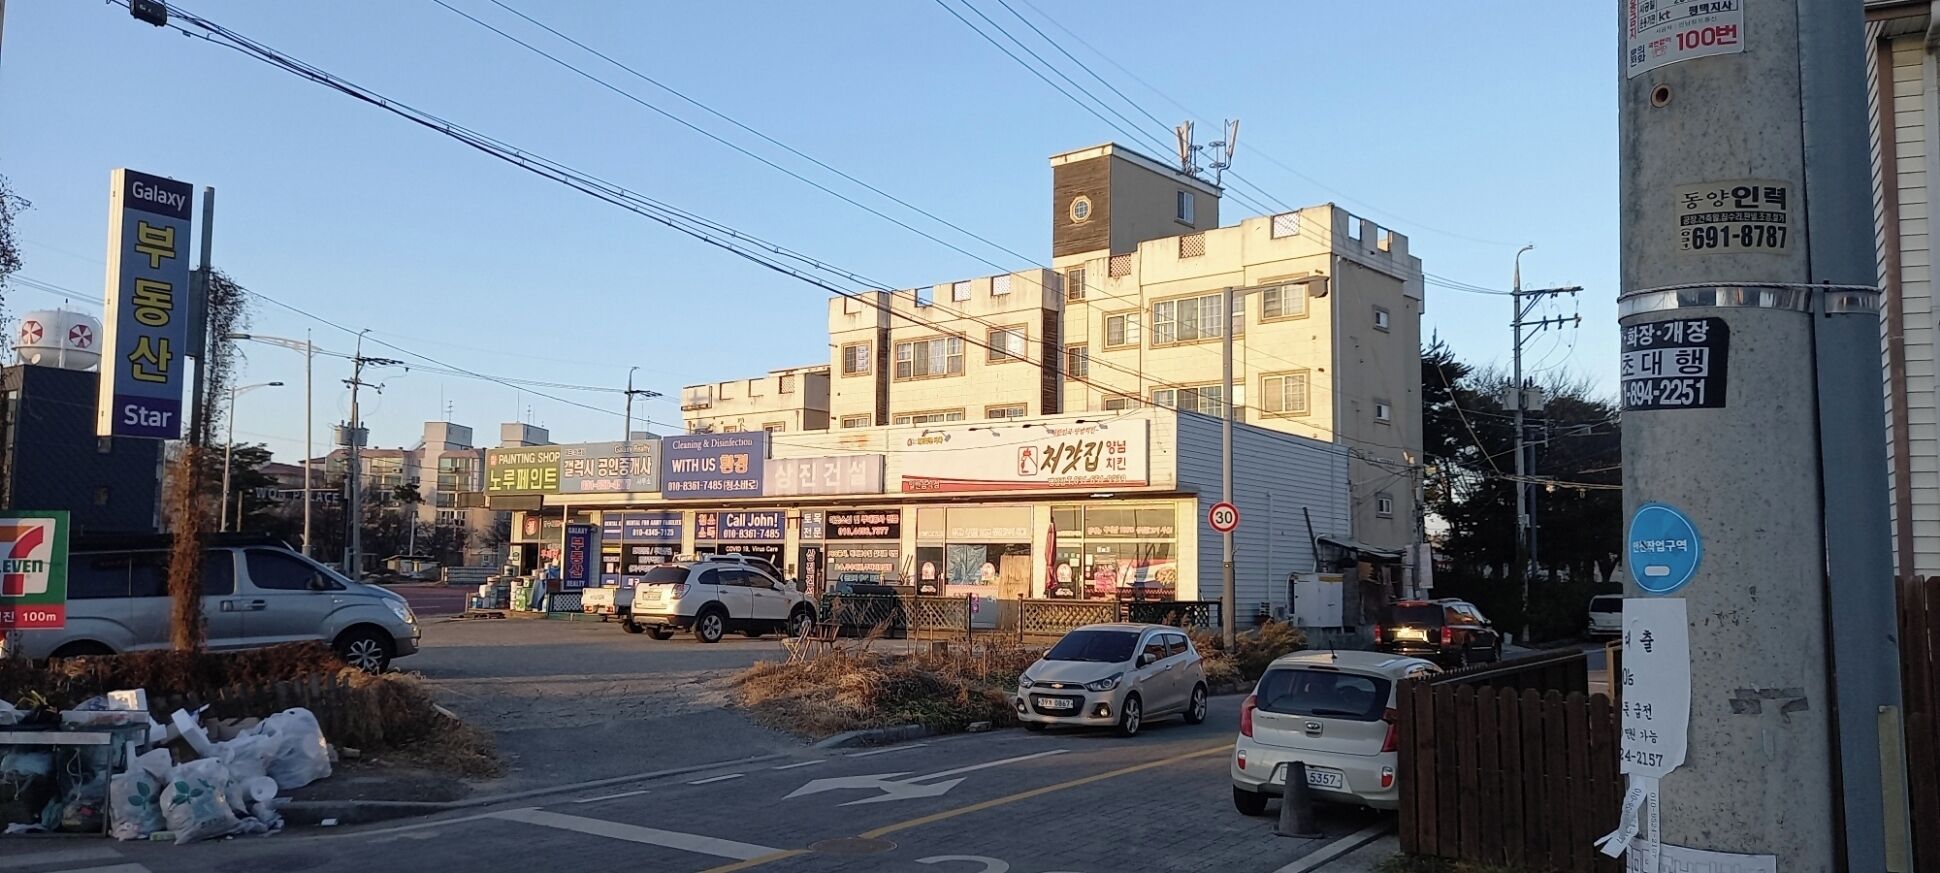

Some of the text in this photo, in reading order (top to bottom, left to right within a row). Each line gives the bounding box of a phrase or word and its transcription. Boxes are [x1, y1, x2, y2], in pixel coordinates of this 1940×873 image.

[1658, 10, 1671, 21] kt
[1689, 1, 1732, 16] 평택지사
[1676, 24, 1737, 51] 100번
[132, 181, 186, 212] Galaxy
[1692, 225, 1787, 249] 691-8787
[128, 220, 175, 384] 부동산
[124, 404, 172, 428] Star
[672, 436, 753, 451] Cleaning & Disinfection
[1106, 440, 1126, 455] 양념
[499, 452, 536, 465] PAINTING
[537, 451, 560, 464] SHOP
[1041, 439, 1103, 474] 처갓집
[1106, 457, 1126, 471] 치킨
[564, 456, 652, 477] 갤럭시 공인중개사
[672, 459, 699, 473] WITH
[701, 457, 716, 472] US
[489, 467, 557, 491] 노루페인트
[726, 512, 778, 528] Call John!
[803, 512, 822, 524] 토목
[1215, 511, 1232, 524] 30
[803, 527, 822, 539] 전문
[569, 537, 584, 578] 부동산
[0, 611, 57, 623] 진 100m
[1640, 729, 1658, 744] 가능
[1309, 772, 1336, 785] 5357
